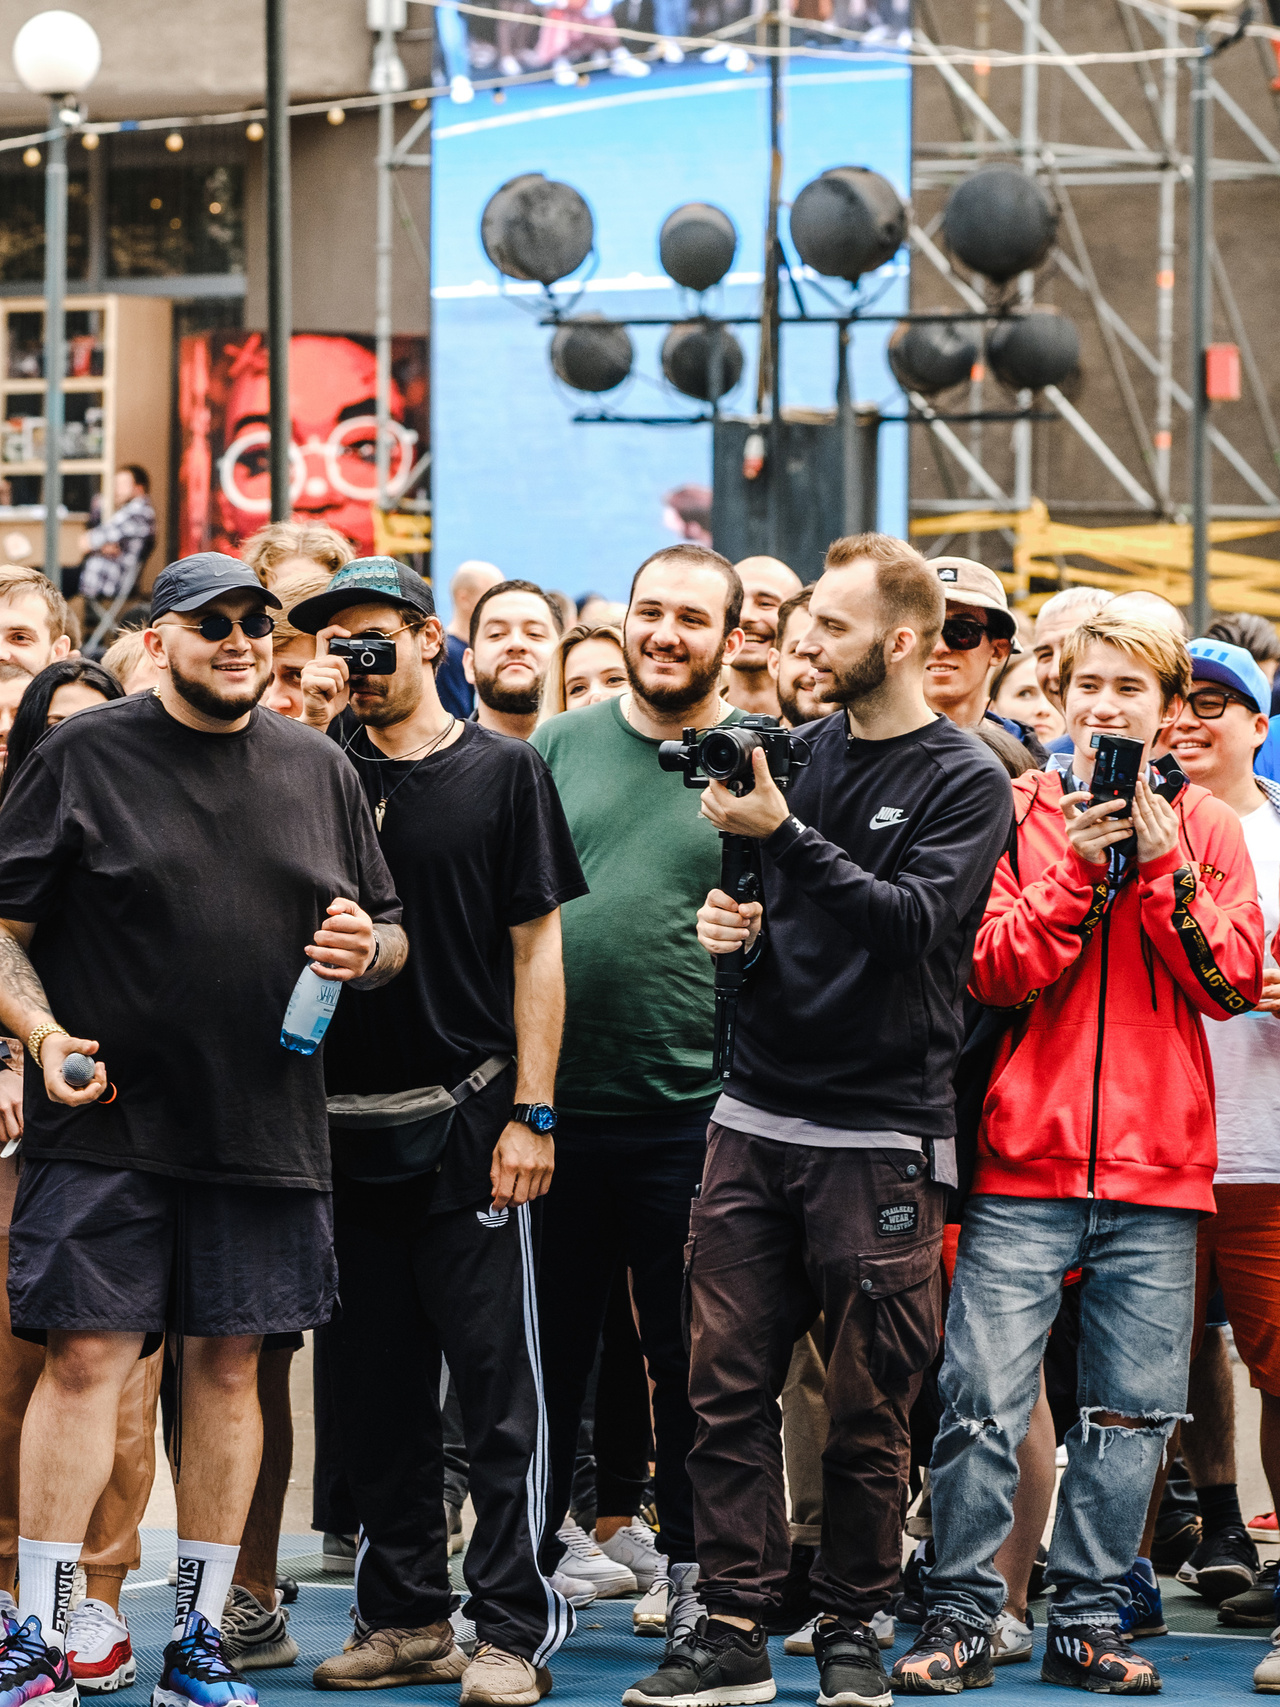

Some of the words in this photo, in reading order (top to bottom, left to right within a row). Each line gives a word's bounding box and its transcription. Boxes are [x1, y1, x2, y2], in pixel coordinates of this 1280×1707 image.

[877, 806, 904, 821] NIKE
[889, 1213, 909, 1224] WEAR
[55, 1562, 77, 1632] STANCE
[176, 1559, 199, 1625] STANCE
